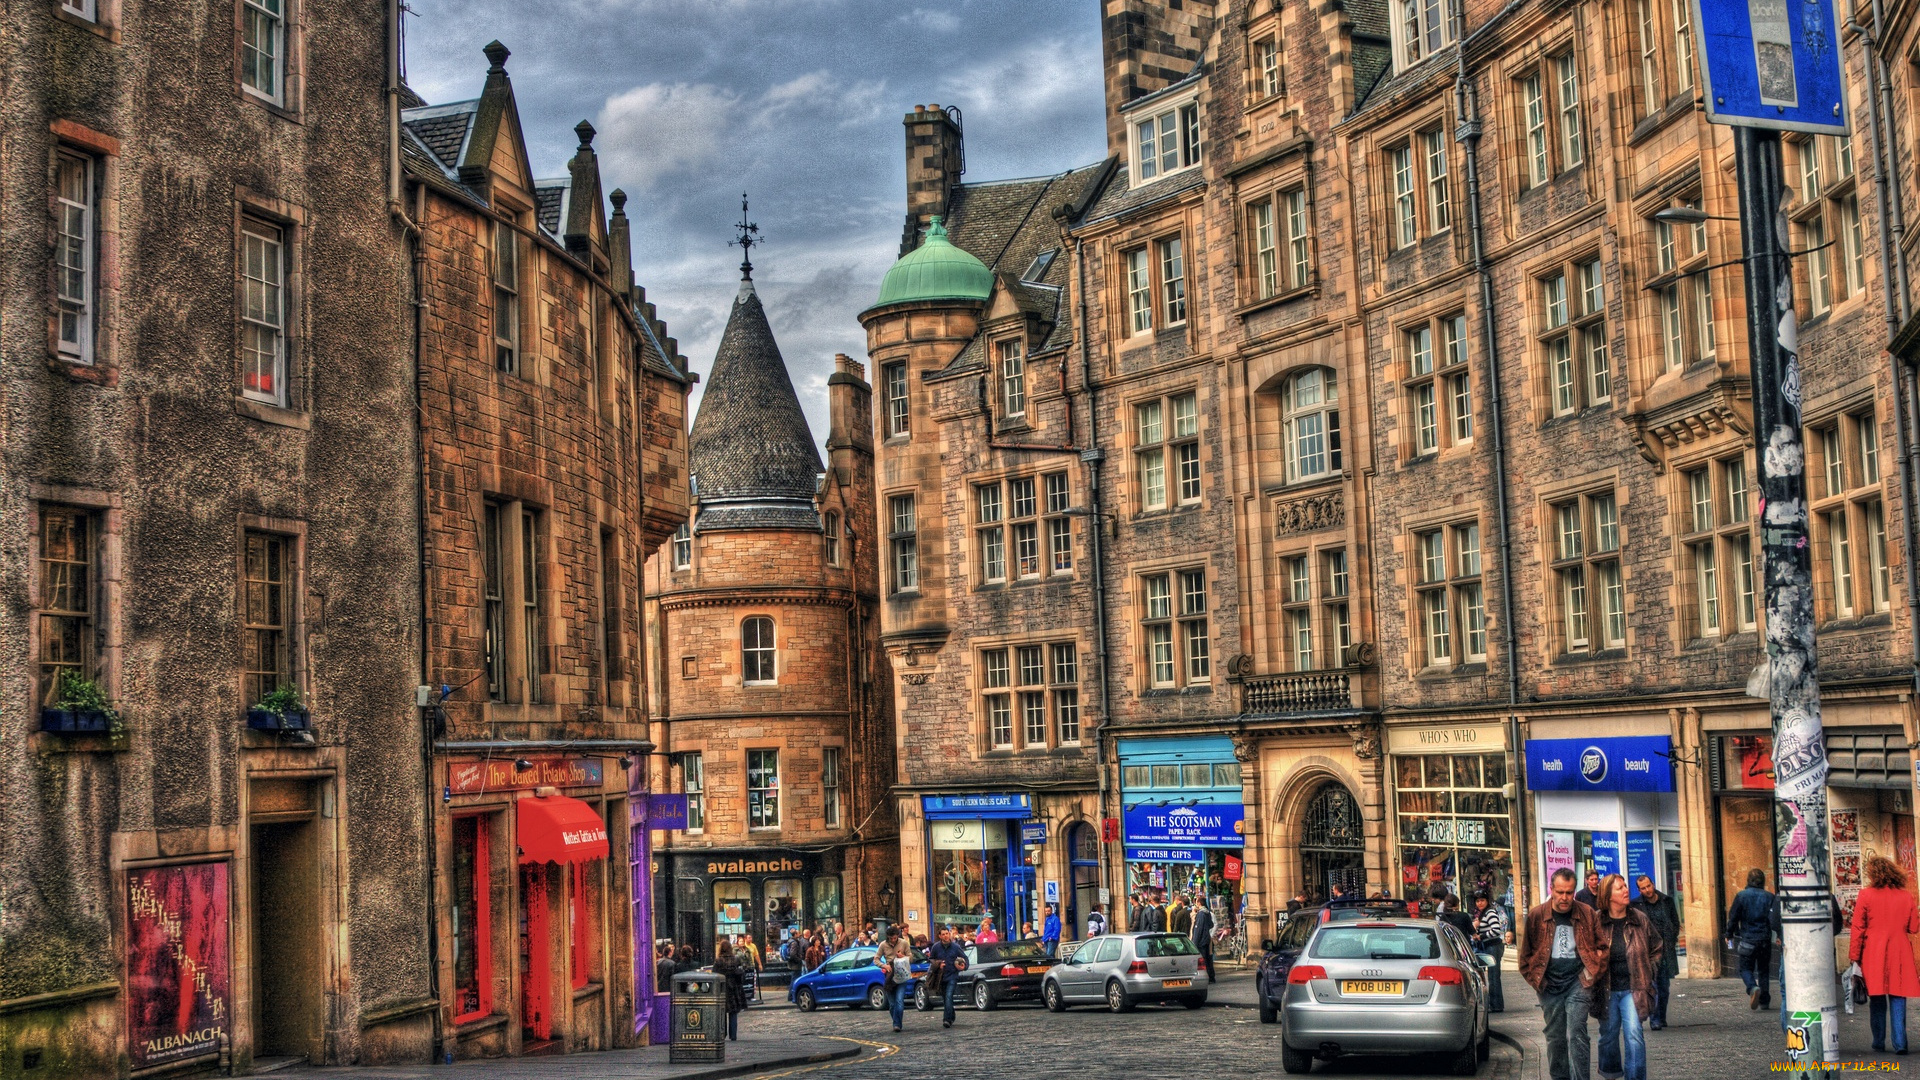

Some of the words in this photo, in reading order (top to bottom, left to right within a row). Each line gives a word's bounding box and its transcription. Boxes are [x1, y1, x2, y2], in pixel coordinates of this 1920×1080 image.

[1419, 730, 1449, 744] WHO'S
[1453, 729, 1476, 742] WHO
[1542, 759, 1563, 771] health
[1624, 758, 1649, 773] beauty
[489, 763, 505, 786] The
[543, 762, 566, 784] Potato
[569, 760, 586, 784] Shop
[1794, 778, 1812, 791] FRI
[1147, 816, 1167, 828] THE
[1168, 816, 1221, 828] SCOTSMAN
[562, 829, 581, 845] Hottest
[1186, 828, 1201, 836] RACK
[1457, 823, 1484, 844] OFF
[1084, 833, 1098, 851] 65
[1546, 839, 1555, 853] 10
[1555, 845, 1569, 854] points
[1594, 838, 1619, 849] welcome
[1137, 850, 1168, 858] SCOTTISH
[1171, 851, 1191, 859] GIFTS
[1554, 856, 1567, 865] every
[707, 857, 803, 874] avalanche
[1347, 981, 1374, 992] FY08
[1377, 981, 1399, 992] UBT
[146, 1026, 221, 1053] ALBANACH
